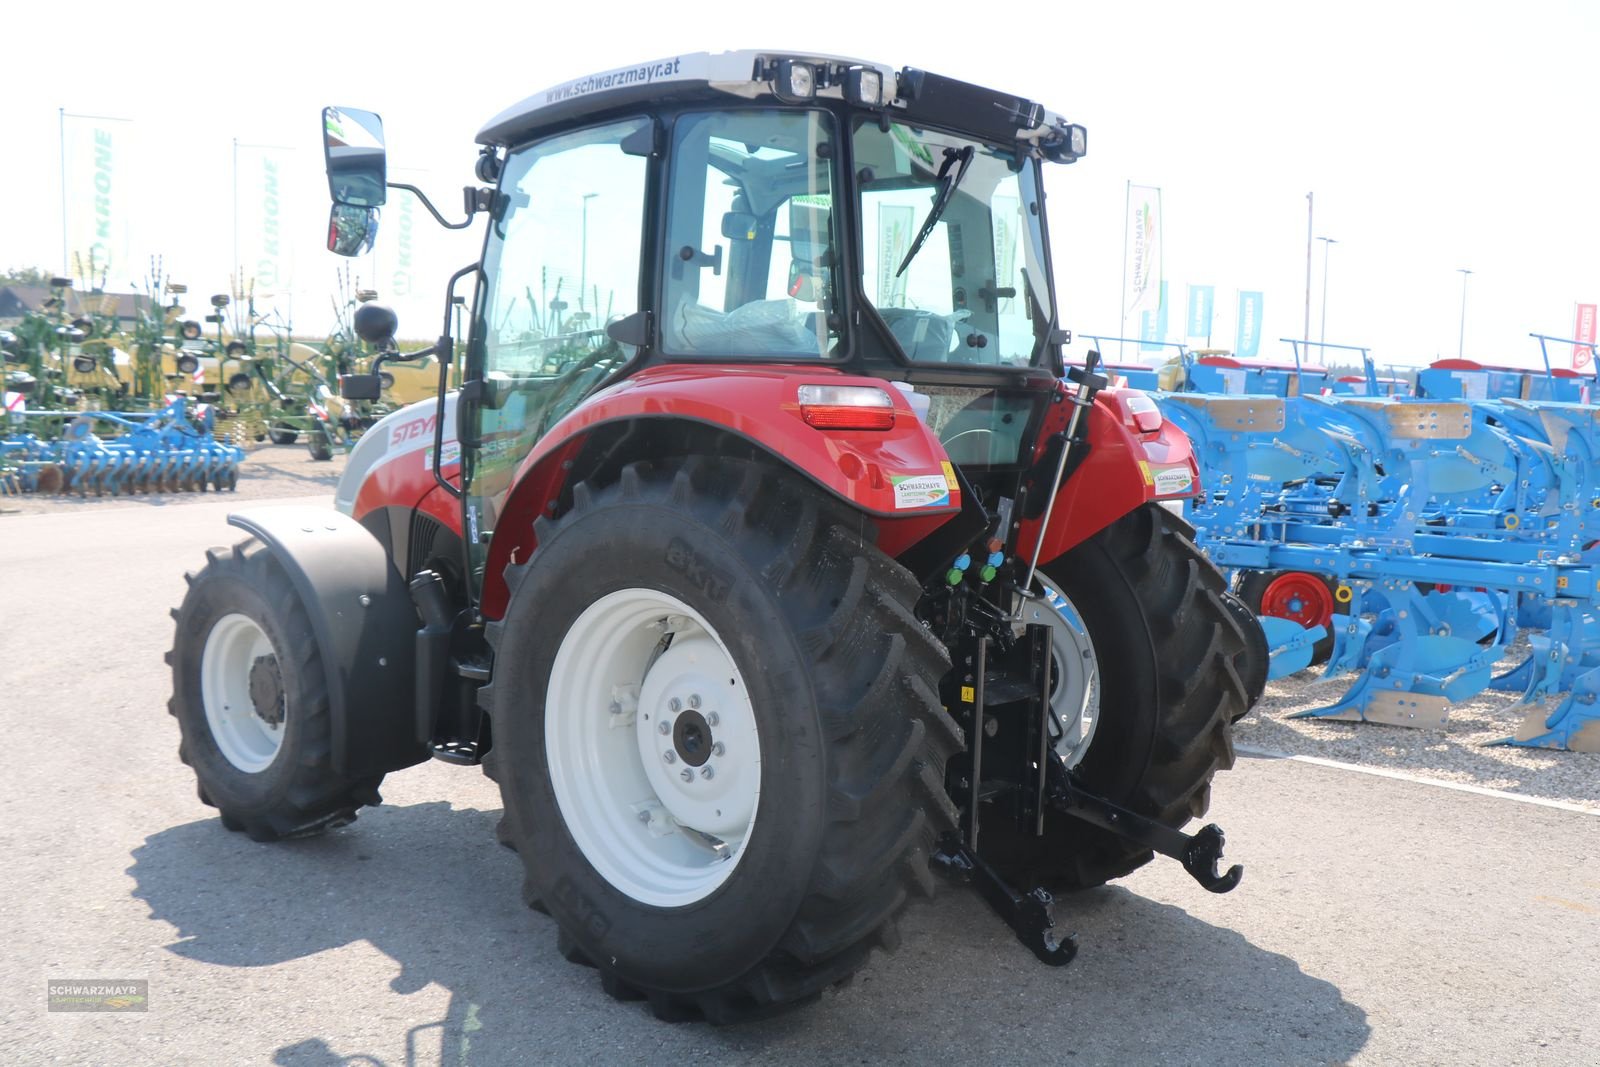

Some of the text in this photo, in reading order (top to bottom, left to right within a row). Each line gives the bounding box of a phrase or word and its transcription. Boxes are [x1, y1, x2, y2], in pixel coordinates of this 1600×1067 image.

[546, 57, 680, 103] www.schwarzmayr.at
[94, 127, 112, 238] KRONE
[264, 157, 279, 256] KRONE
[399, 188, 413, 267] KRON
[1133, 209, 1144, 293] SCHWARZMAYR
[899, 482, 941, 491] SCHWARZMAYR
